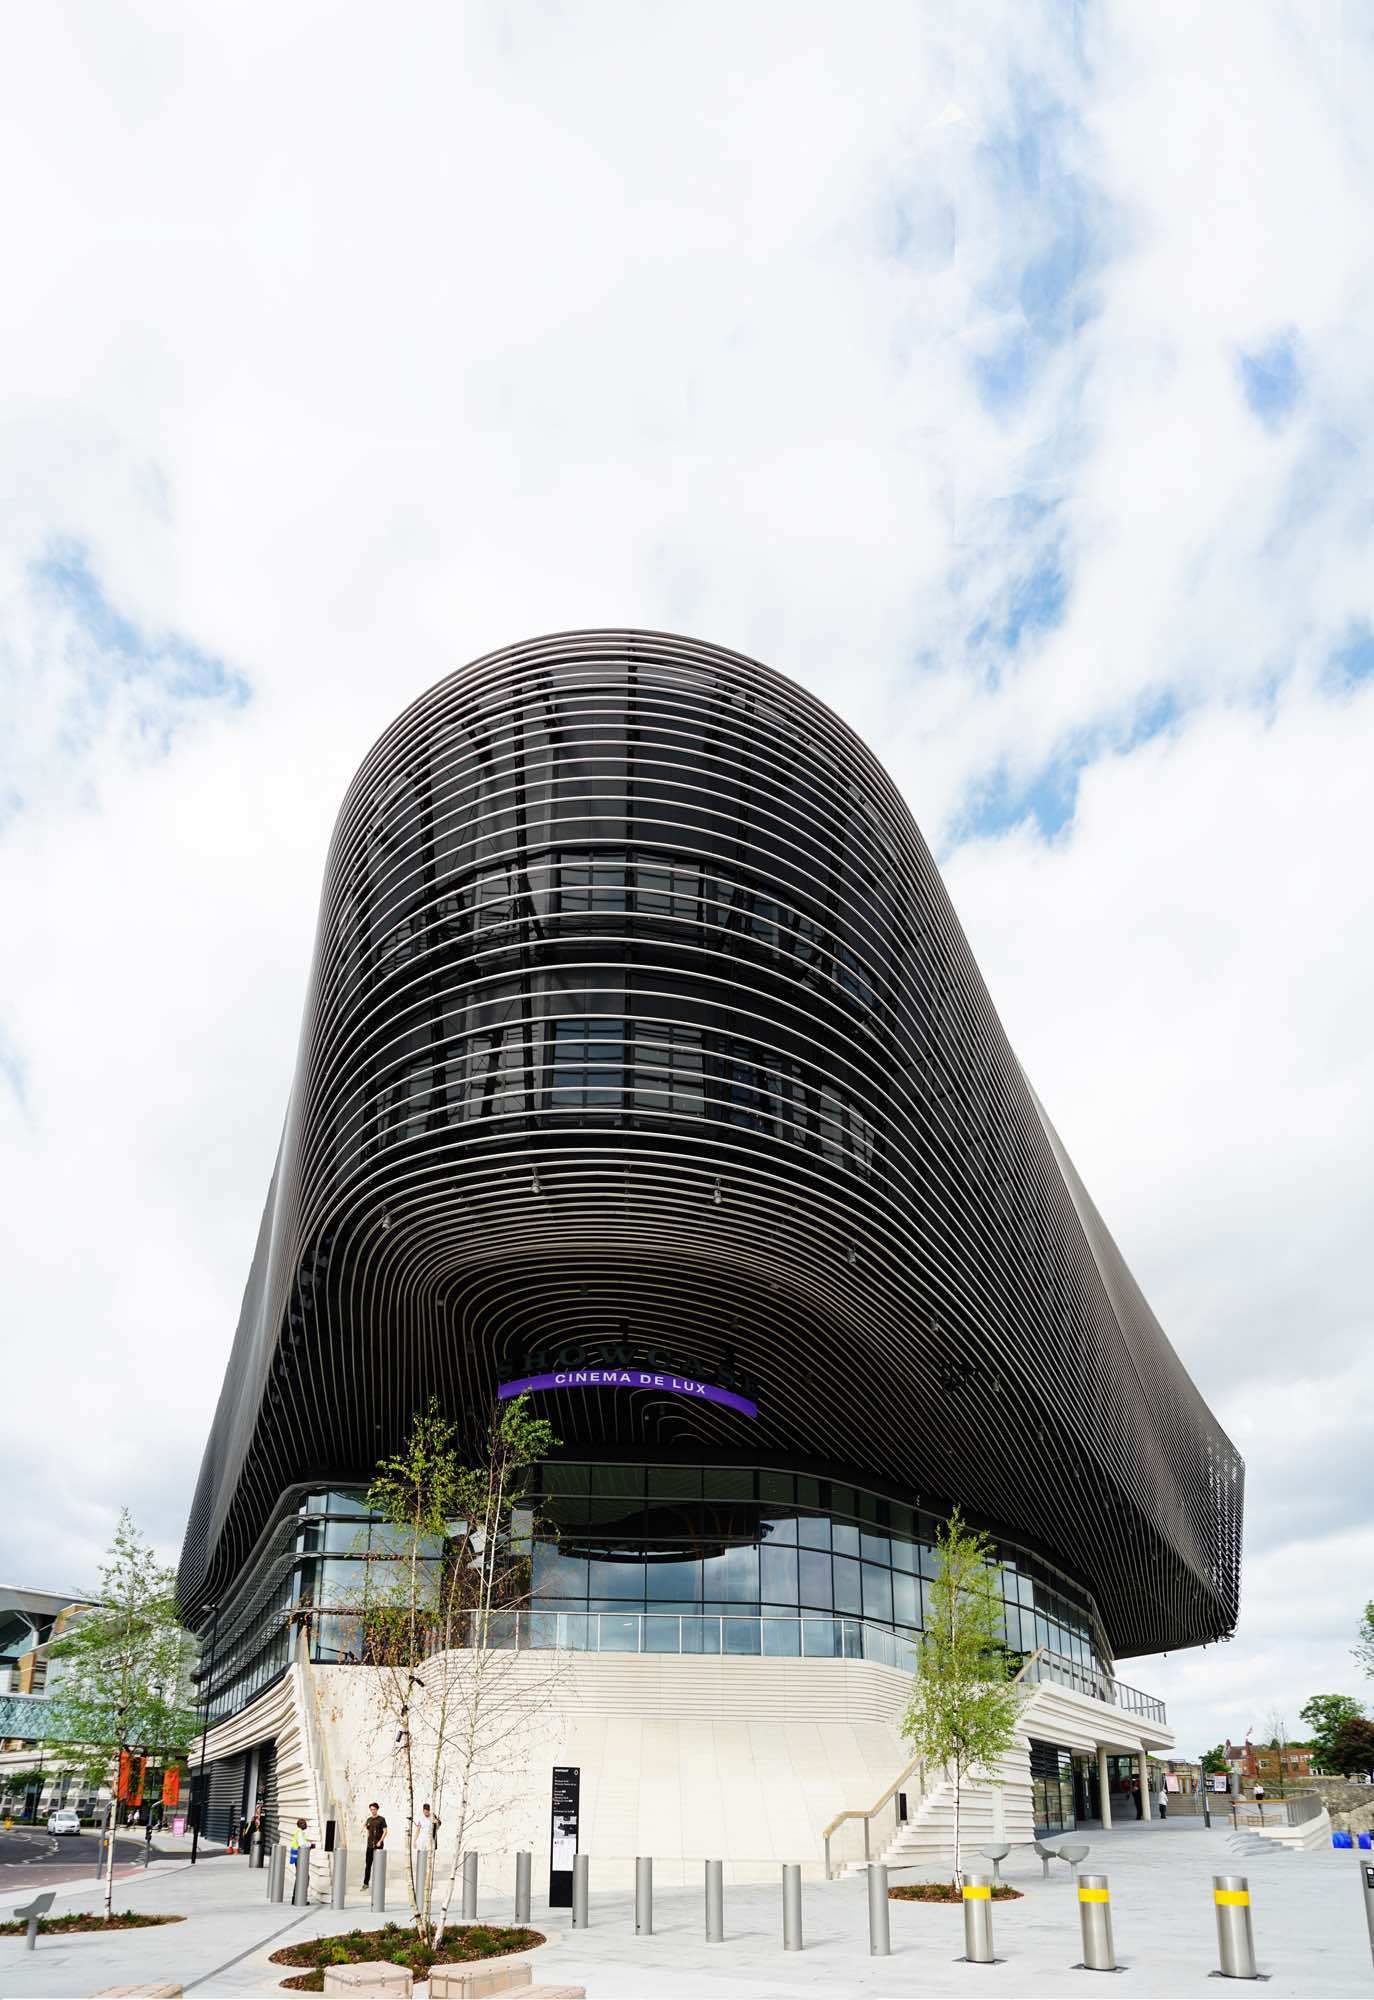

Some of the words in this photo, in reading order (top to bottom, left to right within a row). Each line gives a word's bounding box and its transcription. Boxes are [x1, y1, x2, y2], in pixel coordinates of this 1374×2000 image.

[555, 1372, 631, 1384] CINEMA
[640, 1374, 664, 1386] DE
[672, 1379, 705, 1394] LUX
